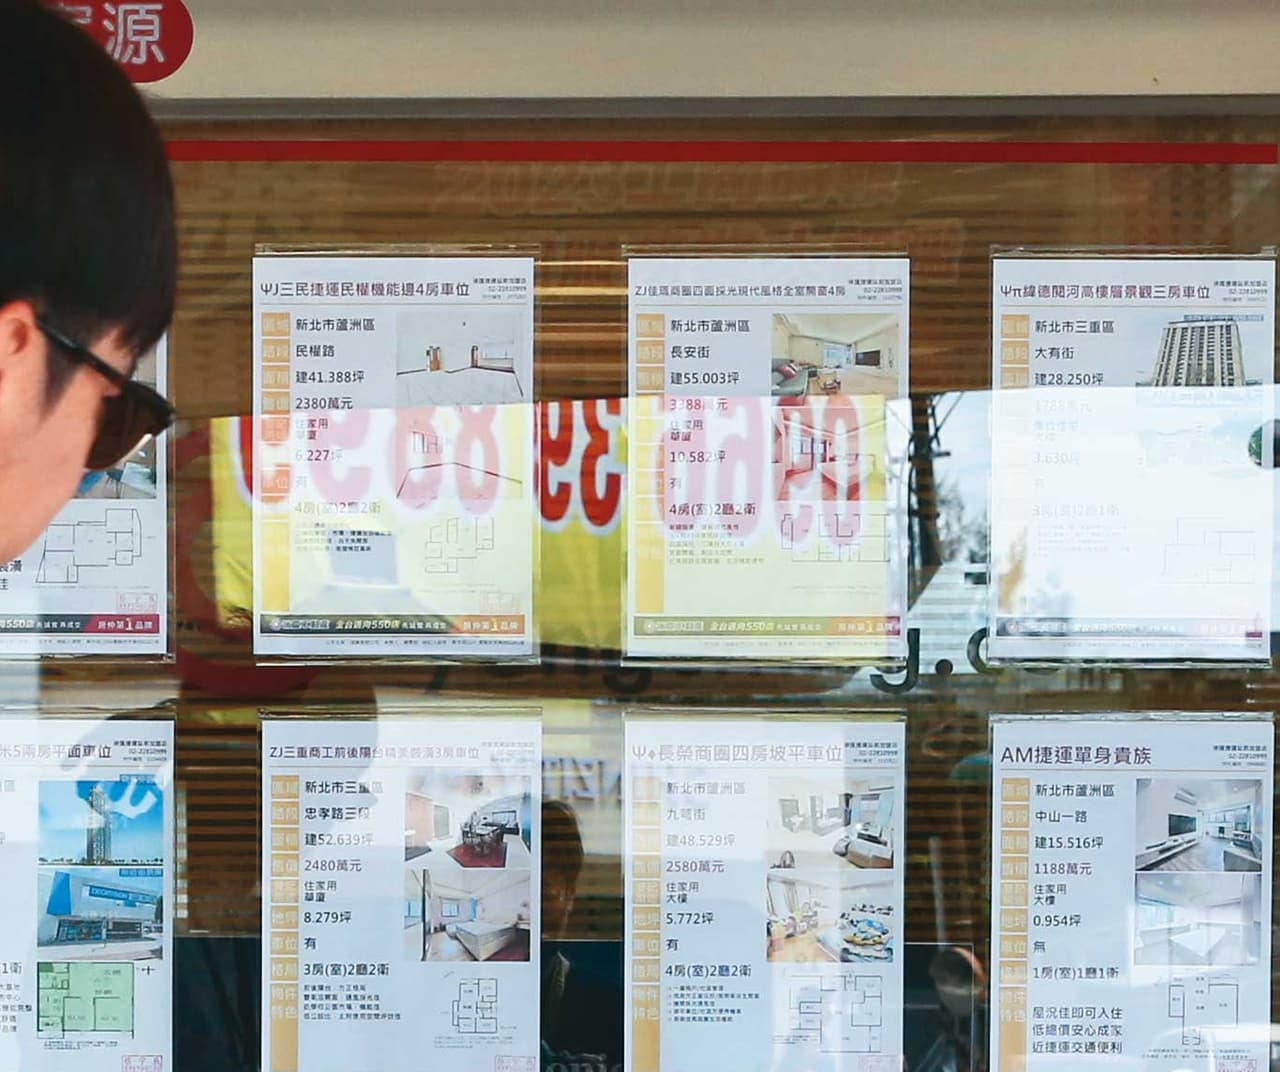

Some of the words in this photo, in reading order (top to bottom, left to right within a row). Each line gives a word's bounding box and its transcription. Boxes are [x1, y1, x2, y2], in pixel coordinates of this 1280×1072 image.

[296, 318, 375, 331] 新北市蘆洲區
[671, 320, 750, 332] 新北市蘆洲區
[1035, 320, 1114, 333] 新北市三重區
[296, 345, 335, 357] 民權路
[671, 346, 709, 359] 長安街
[1035, 347, 1074, 359] 大有街
[296, 371, 364, 383] 建41.388坪
[671, 371, 739, 385] 建55.003坪
[1035, 372, 1103, 386] 建28.250坪
[296, 397, 353, 409] 2380萬元
[1001, 746, 1151, 765] AM捷運單身貴族
[1035, 785, 1114, 797] 新北市蘆洲區
[1035, 811, 1087, 823] 中山一路
[1035, 837, 1104, 849] 建15.516坪
[304, 859, 362, 872] 2480萬元
[666, 861, 724, 873] 2580萬元
[1034, 863, 1092, 875] 1188萬元
[1034, 884, 1067, 894] 住家用
[304, 911, 352, 923] 8.279坪
[666, 912, 714, 924] 5.772坪
[1033, 915, 1081, 927] 0.954坪
[304, 963, 390, 976] 3房(室)2廳2衛
[665, 965, 751, 977] 4房(室)2廳2衛
[1033, 966, 1119, 980] 1房(室)1廳1衛
[1033, 1007, 1123, 1019] 屋況佳即可入住
[1033, 1024, 1123, 1037] 低總價安心成家
[1032, 1041, 1122, 1054] 近捷運交通便利
